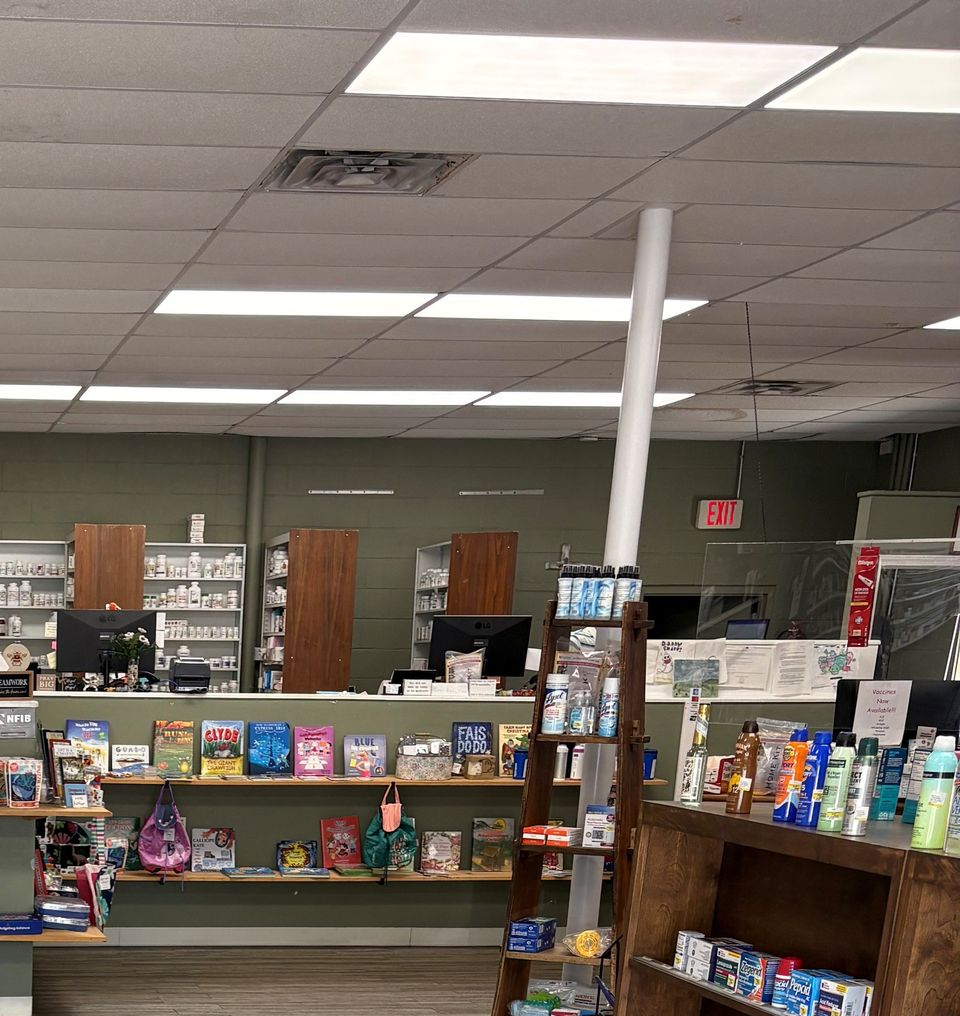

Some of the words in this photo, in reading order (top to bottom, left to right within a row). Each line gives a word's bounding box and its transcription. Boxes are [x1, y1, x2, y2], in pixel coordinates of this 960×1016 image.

[707, 501, 737, 526] EXIT
[546, 692, 564, 704] Lysol
[6, 714, 32, 723] NFIB
[205, 728, 239, 742] CLYDE
[458, 726, 486, 740] FAIS
[354, 738, 374, 746] BLUE
[766, 763, 777, 789] HOME
[772, 746, 781, 760] KIT
[741, 962, 762, 977] Zegerid
[790, 978, 812, 996] Pepcid
